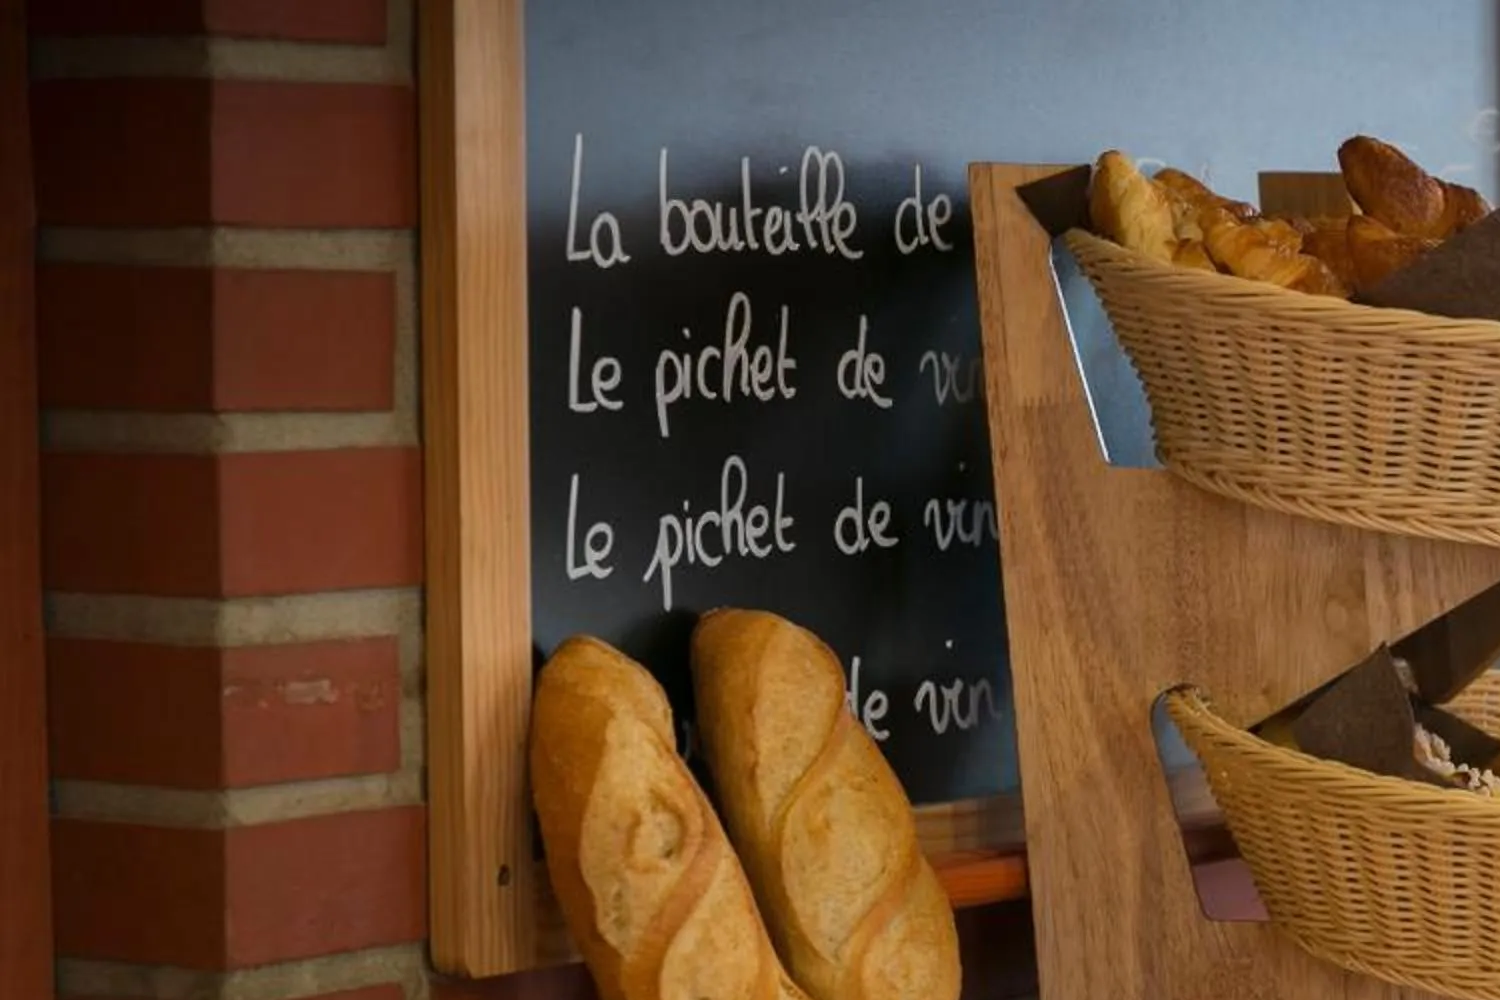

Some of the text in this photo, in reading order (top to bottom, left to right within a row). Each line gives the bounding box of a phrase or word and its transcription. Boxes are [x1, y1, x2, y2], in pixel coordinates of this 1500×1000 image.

[566, 132, 954, 269] La bouteille de
[568, 306, 624, 413] Le
[655, 291, 797, 438] pichet
[837, 314, 893, 408] de
[566, 455, 999, 612] Le pichet de vin
[913, 639, 1002, 734] vin
